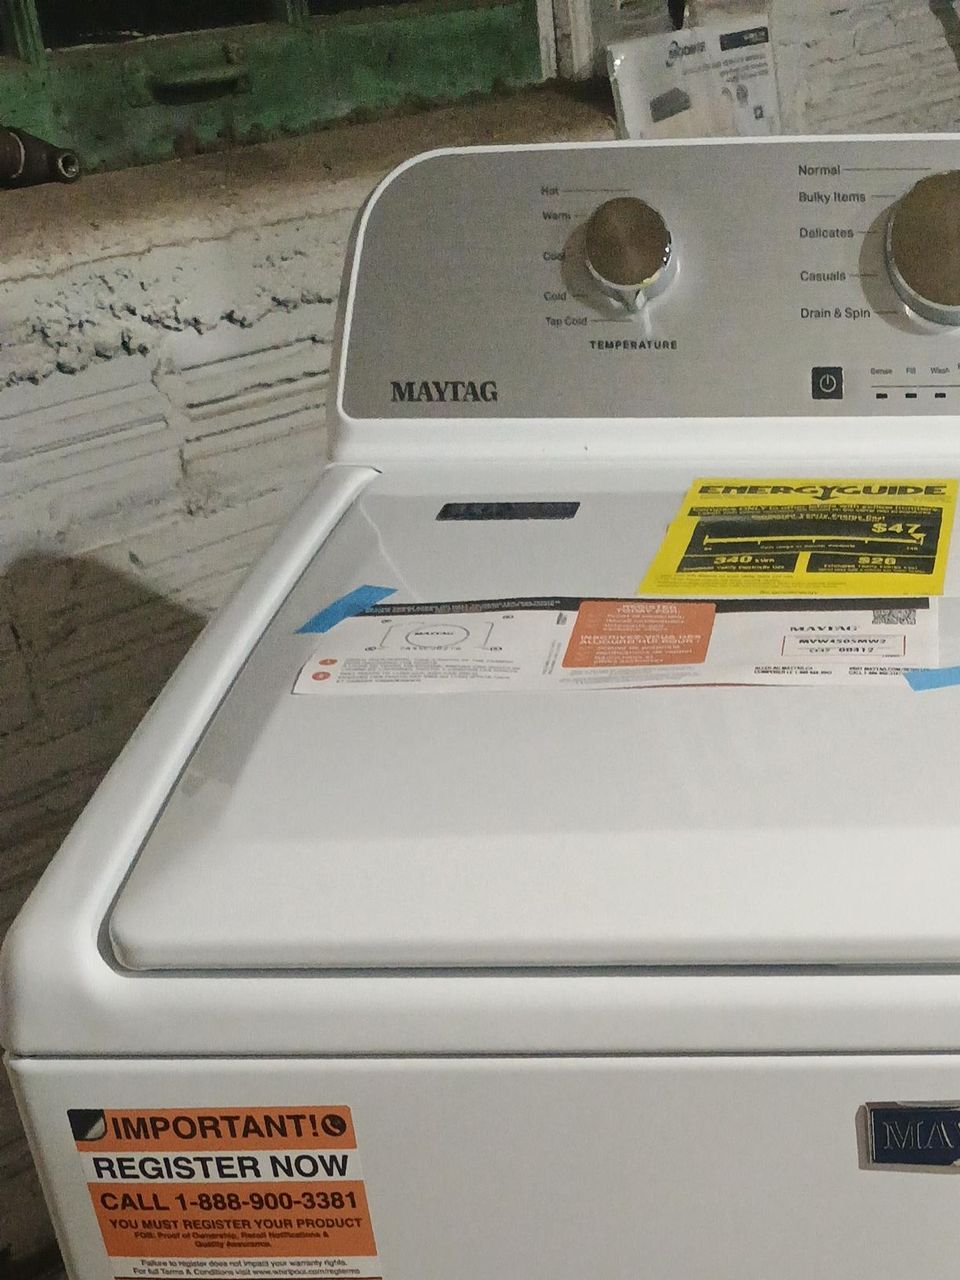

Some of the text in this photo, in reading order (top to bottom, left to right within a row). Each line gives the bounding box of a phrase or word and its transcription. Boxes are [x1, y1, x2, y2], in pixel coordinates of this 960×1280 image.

[798, 165, 840, 176] Normal
[541, 186, 559, 195] Hot
[799, 192, 866, 204] Bulky Items
[542, 211, 571, 220] Warm
[800, 228, 854, 239] Delicates
[543, 252, 565, 261] Cool
[800, 271, 846, 281] Casuals
[544, 292, 567, 301] Cold
[800, 308, 870, 320] Drain & Spin
[545, 317, 587, 328] Tap Cold
[590, 340, 677, 349] TEMPERATURE
[390, 381, 498, 402] MAYTAG
[699, 485, 947, 499] ENERGYGUIDE
[871, 522, 921, 534] $47
[714, 555, 753, 565] 340
[112, 1113, 319, 1140] IMPORTANT!
[92, 1154, 348, 1180] REGISTER NOW
[100, 1190, 357, 1212] CALL 1-888-900-3381
[109, 1218, 362, 1230] YOU MUST REGISTER YOUR PRODUCT
[178, 1260, 207, 1268] register
[244, 1260, 269, 1268] impact
[289, 1260, 322, 1268] warranty
[324, 1259, 348, 1267] rights.
[133, 1267, 146, 1275] For
[194, 1268, 234, 1276] Conditions
